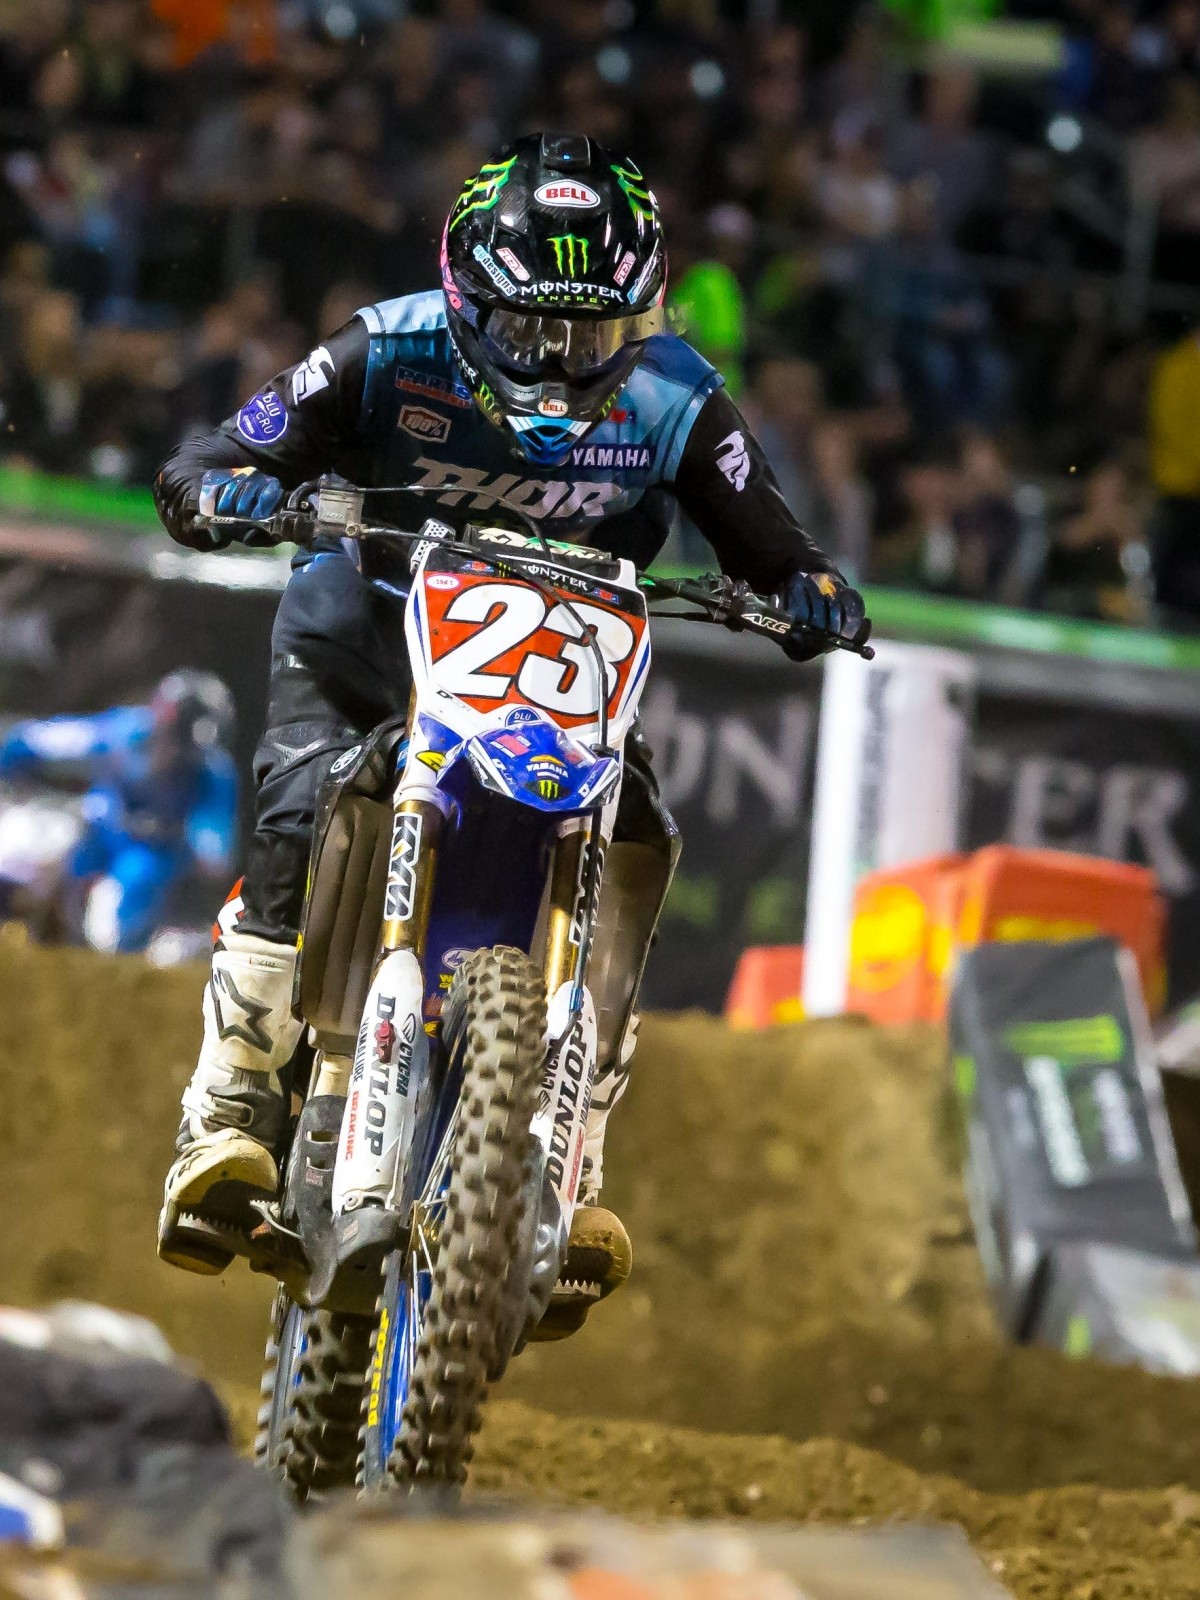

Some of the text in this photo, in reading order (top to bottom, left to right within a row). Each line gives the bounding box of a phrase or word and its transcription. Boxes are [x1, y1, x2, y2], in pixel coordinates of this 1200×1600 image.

[545, 187, 591, 202] BELL
[521, 280, 624, 303] MONSTER
[537, 295, 610, 305] ENERGY
[405, 413, 444, 437] 100%
[572, 448, 650, 468] YAMAHA
[413, 456, 624, 519] THOR
[512, 564, 588, 592] ONSTER
[740, 613, 791, 634] ARC
[432, 581, 638, 718] 23
[525, 762, 569, 779] YAMAHA
[364, 992, 397, 1157] DNLOP
[396, 1042, 414, 1098] CYCRA
[549, 1020, 587, 1191] DUNLOP
